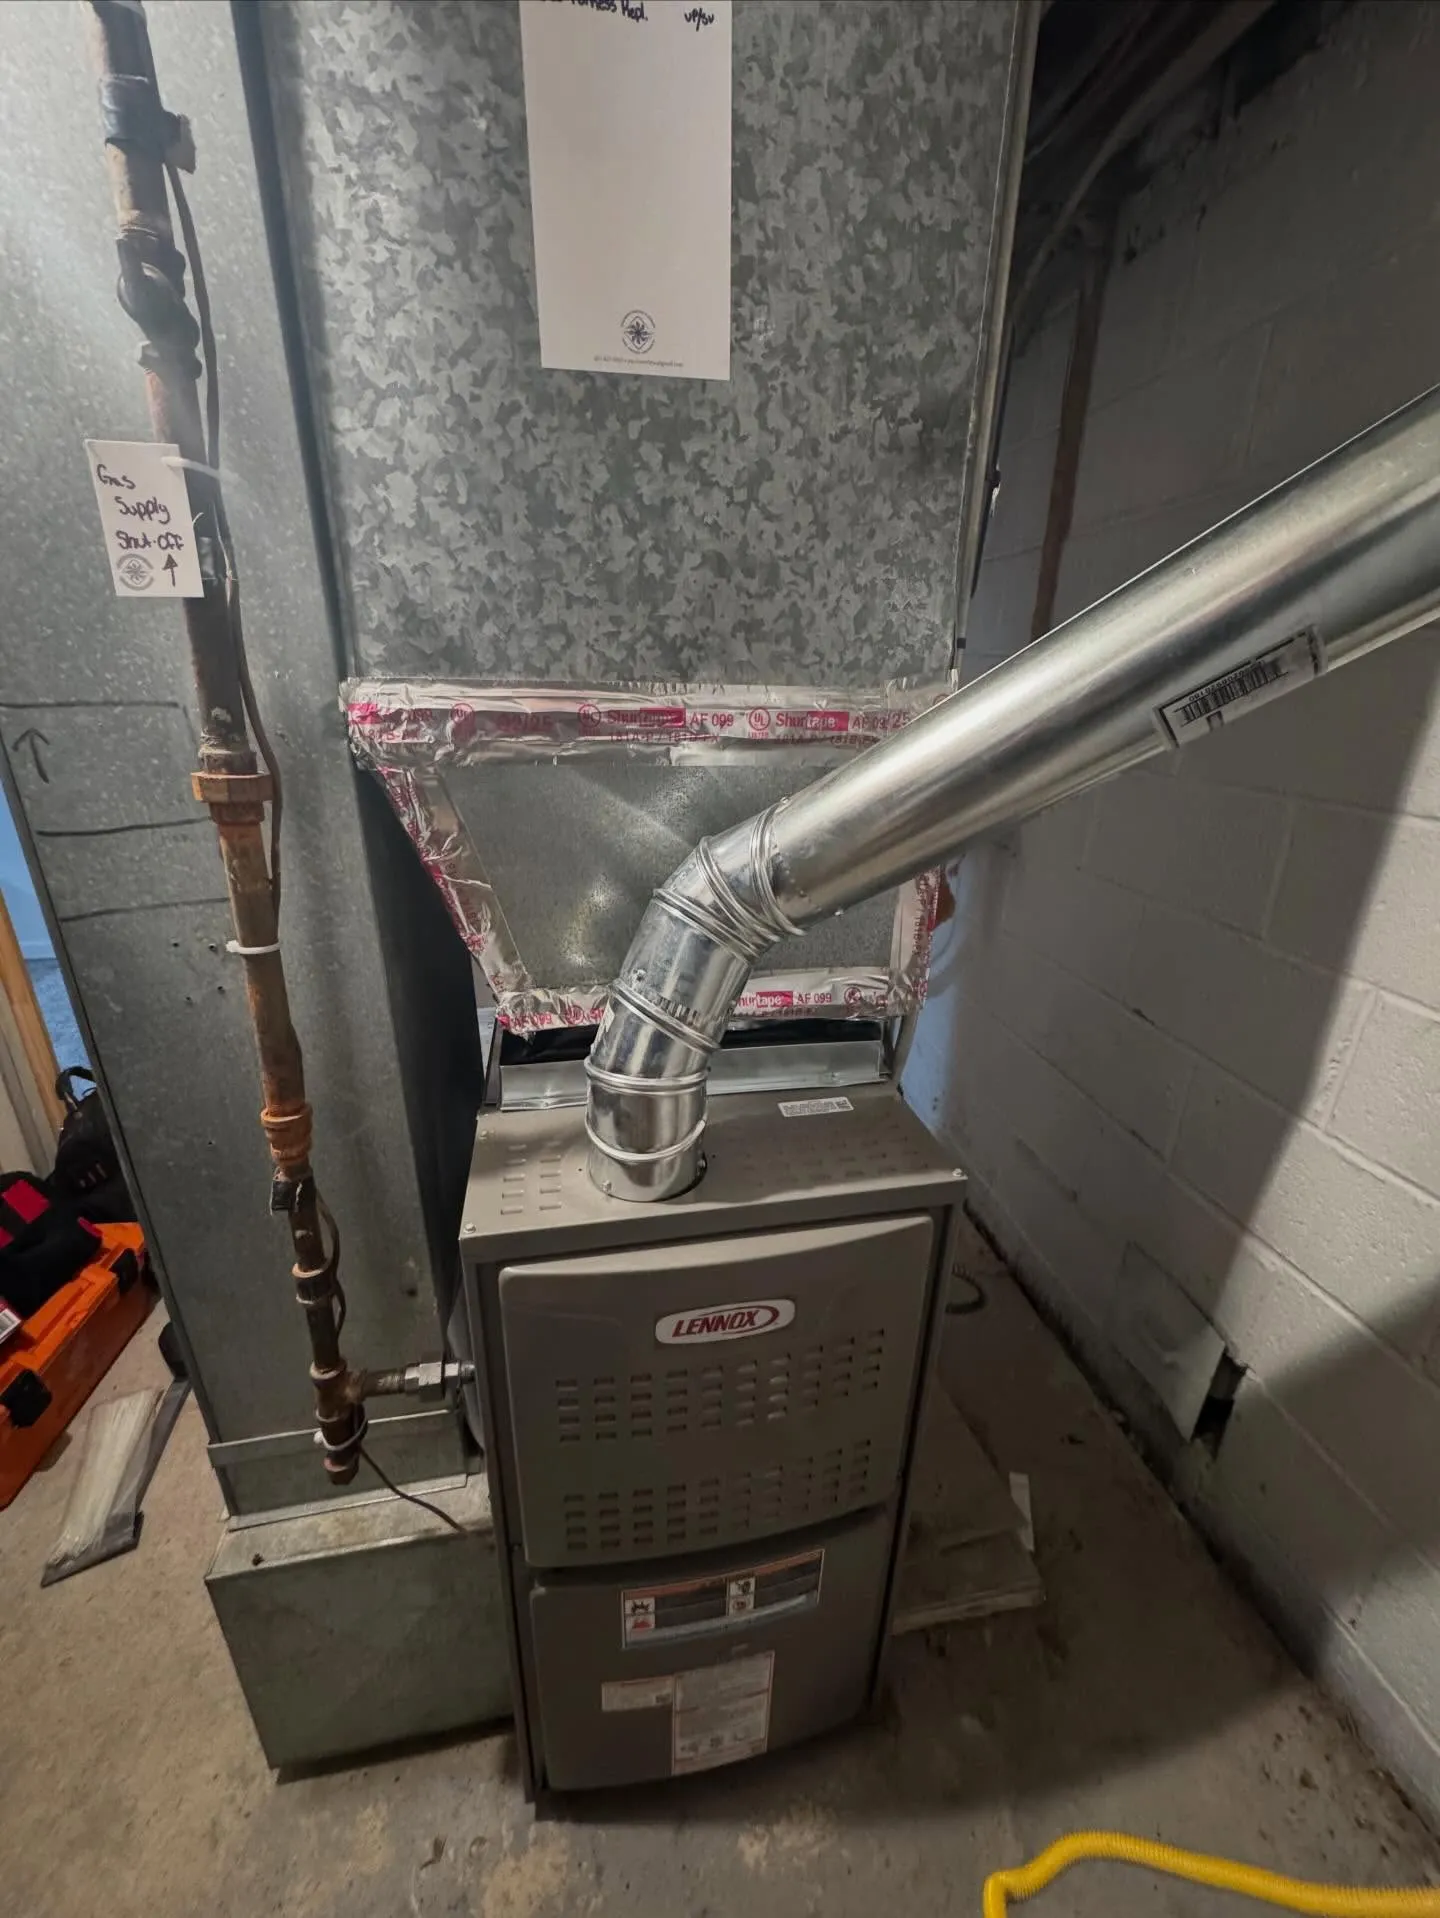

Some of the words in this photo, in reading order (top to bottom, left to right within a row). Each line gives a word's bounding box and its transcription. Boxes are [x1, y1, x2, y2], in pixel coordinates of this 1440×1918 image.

[97, 464, 136, 489] Gas
[115, 496, 170, 524] Supply
[690, 712, 708, 726] AF
[712, 713, 734, 728] 099
[776, 713, 836, 730] Shurtape
[797, 993, 812, 1005] AF
[814, 993, 833, 1004] 099
[671, 1310, 760, 1338] LENNOX
